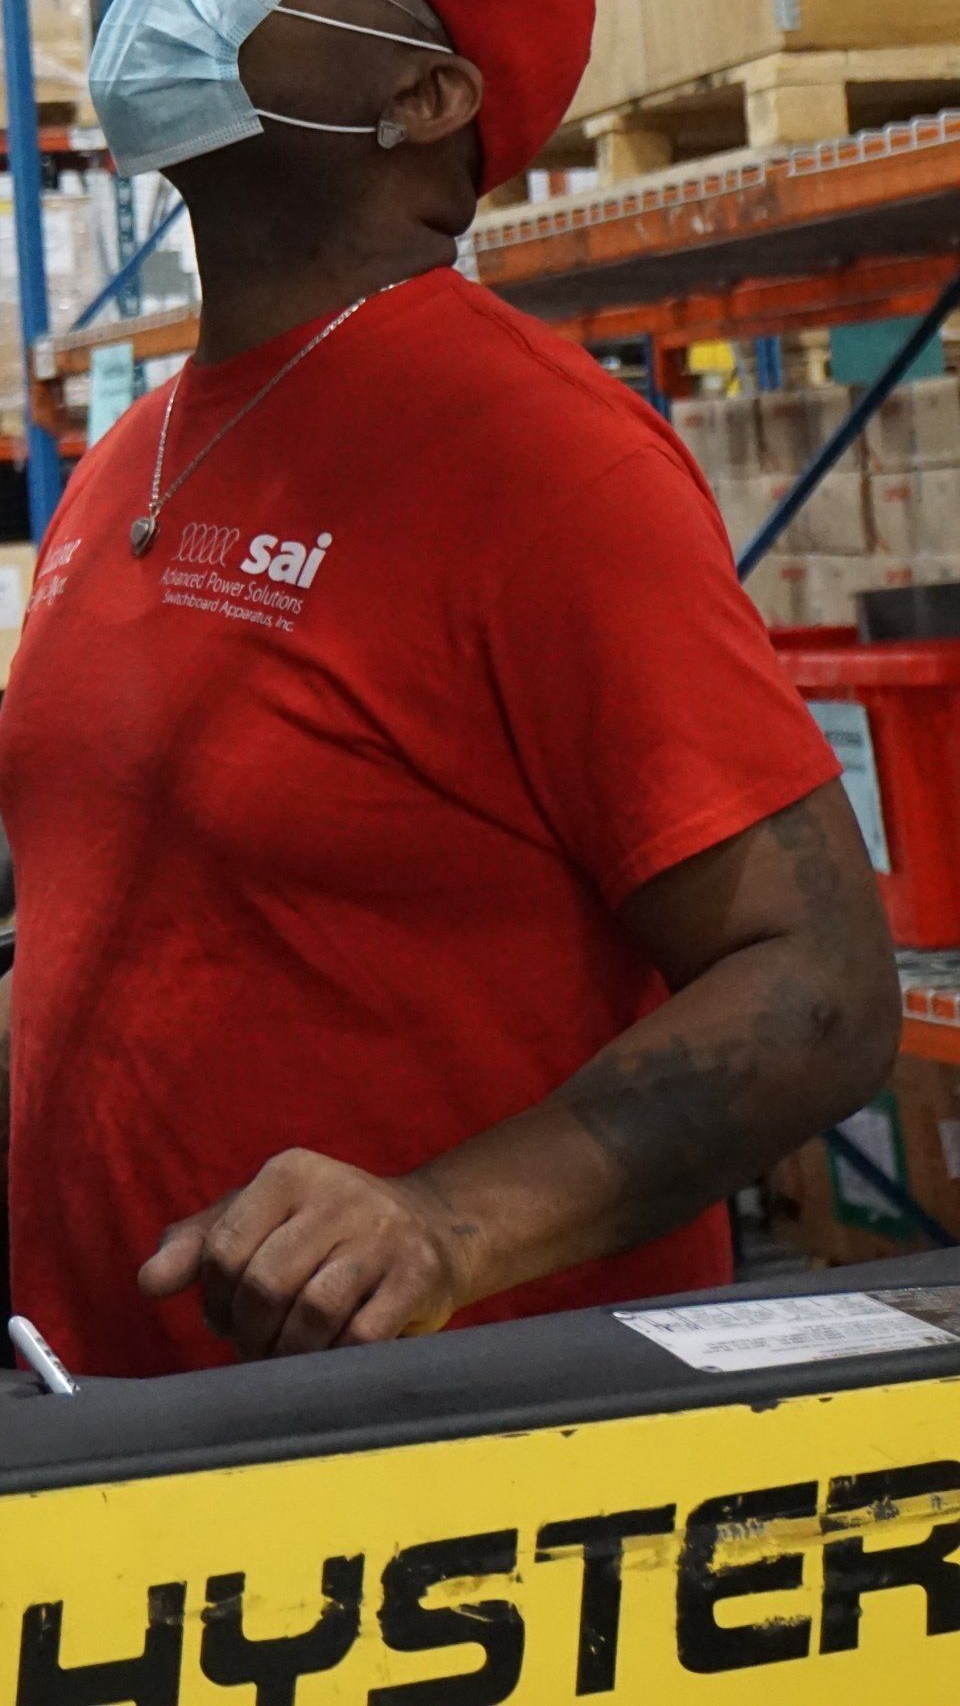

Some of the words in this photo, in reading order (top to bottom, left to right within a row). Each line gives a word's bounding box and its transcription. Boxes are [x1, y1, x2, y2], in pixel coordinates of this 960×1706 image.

[240, 531, 334, 590] sai
[161, 566, 208, 590] Advanced
[205, 571, 245, 597] Power
[243, 580, 304, 615] Solutions
[161, 590, 220, 613] Switchboard
[274, 615, 296, 633] Inc.
[14, 1458, 960, 1706] HYSTER
